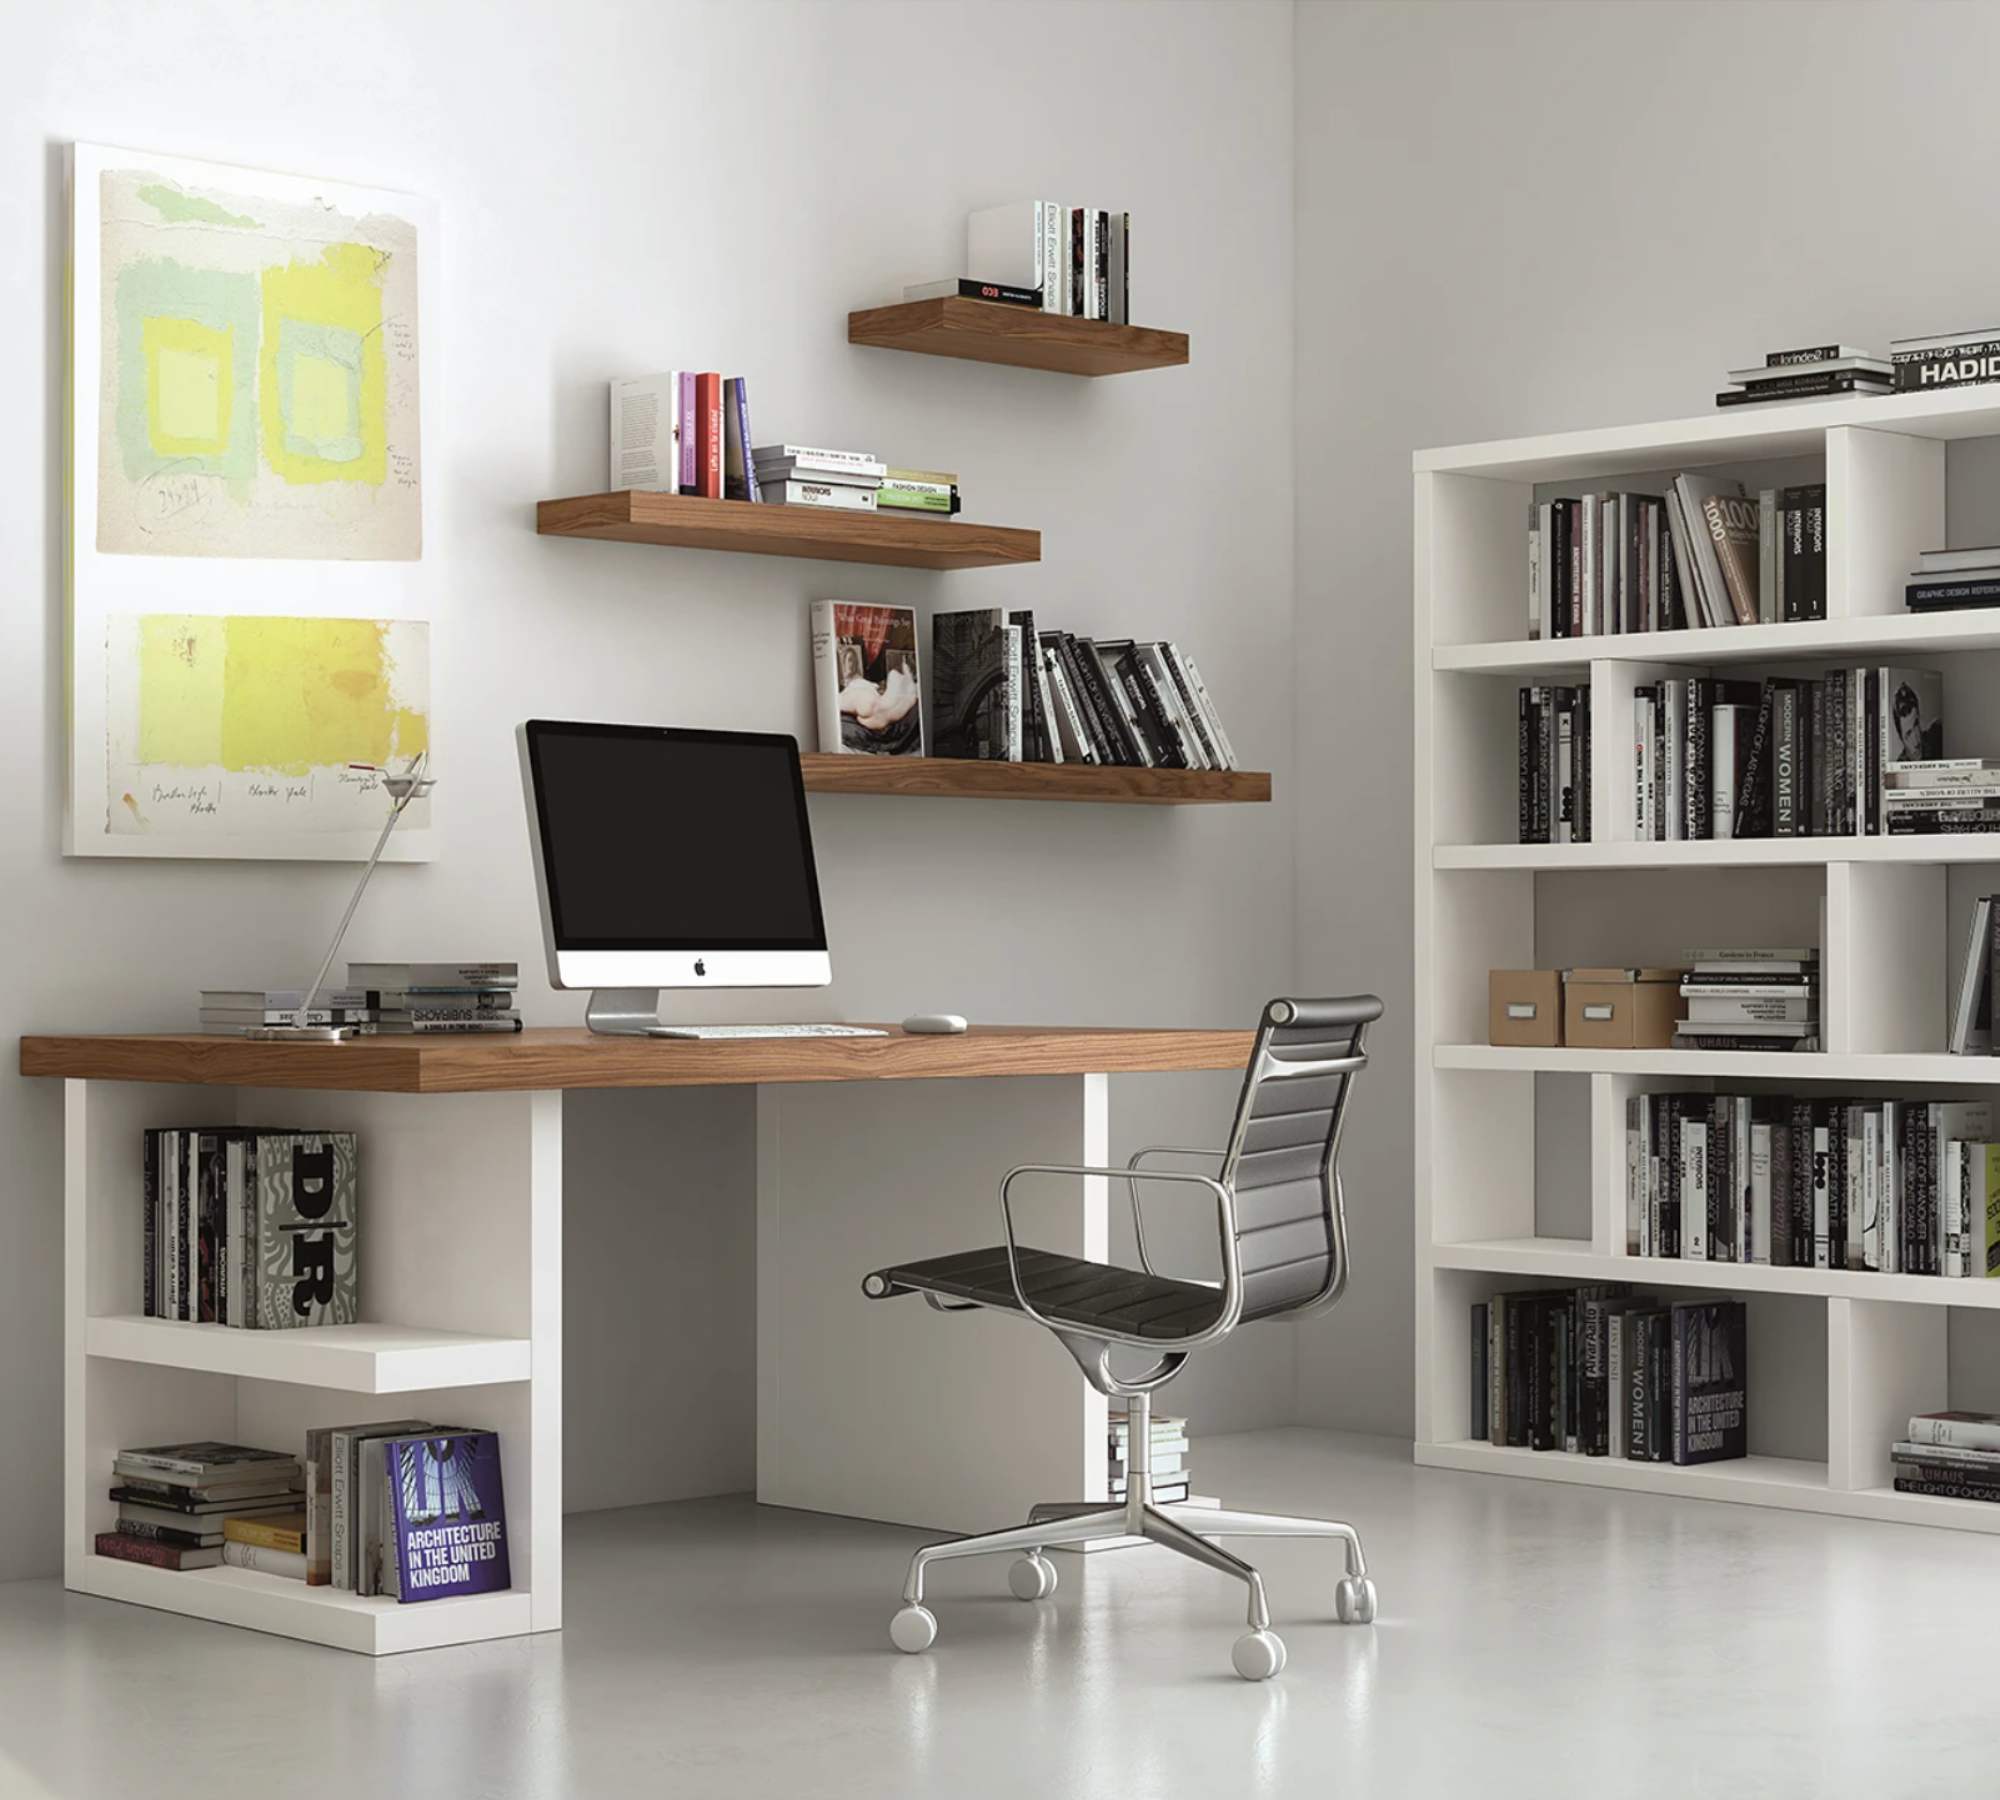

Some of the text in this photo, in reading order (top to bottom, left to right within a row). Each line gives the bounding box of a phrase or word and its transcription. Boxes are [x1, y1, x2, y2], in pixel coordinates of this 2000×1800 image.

[1920, 356, 2000, 385] HADID
[1703, 500, 1726, 541] 1000
[1779, 744, 1791, 821] WOMEN
[1632, 1369, 1644, 1444] WOMEN
[1687, 1391, 1744, 1414] ARCHITECTURE
[1687, 1410, 1740, 1433] IN THE UNITED
[1687, 1430, 1724, 1453] KINGDOM
[334, 1436, 345, 1570] Elliott Erwitt Snaps
[407, 1521, 502, 1550] ARCHITECTURE
[408, 1541, 496, 1570] IN THE UNITED
[410, 1563, 470, 1589] KINGDOM
